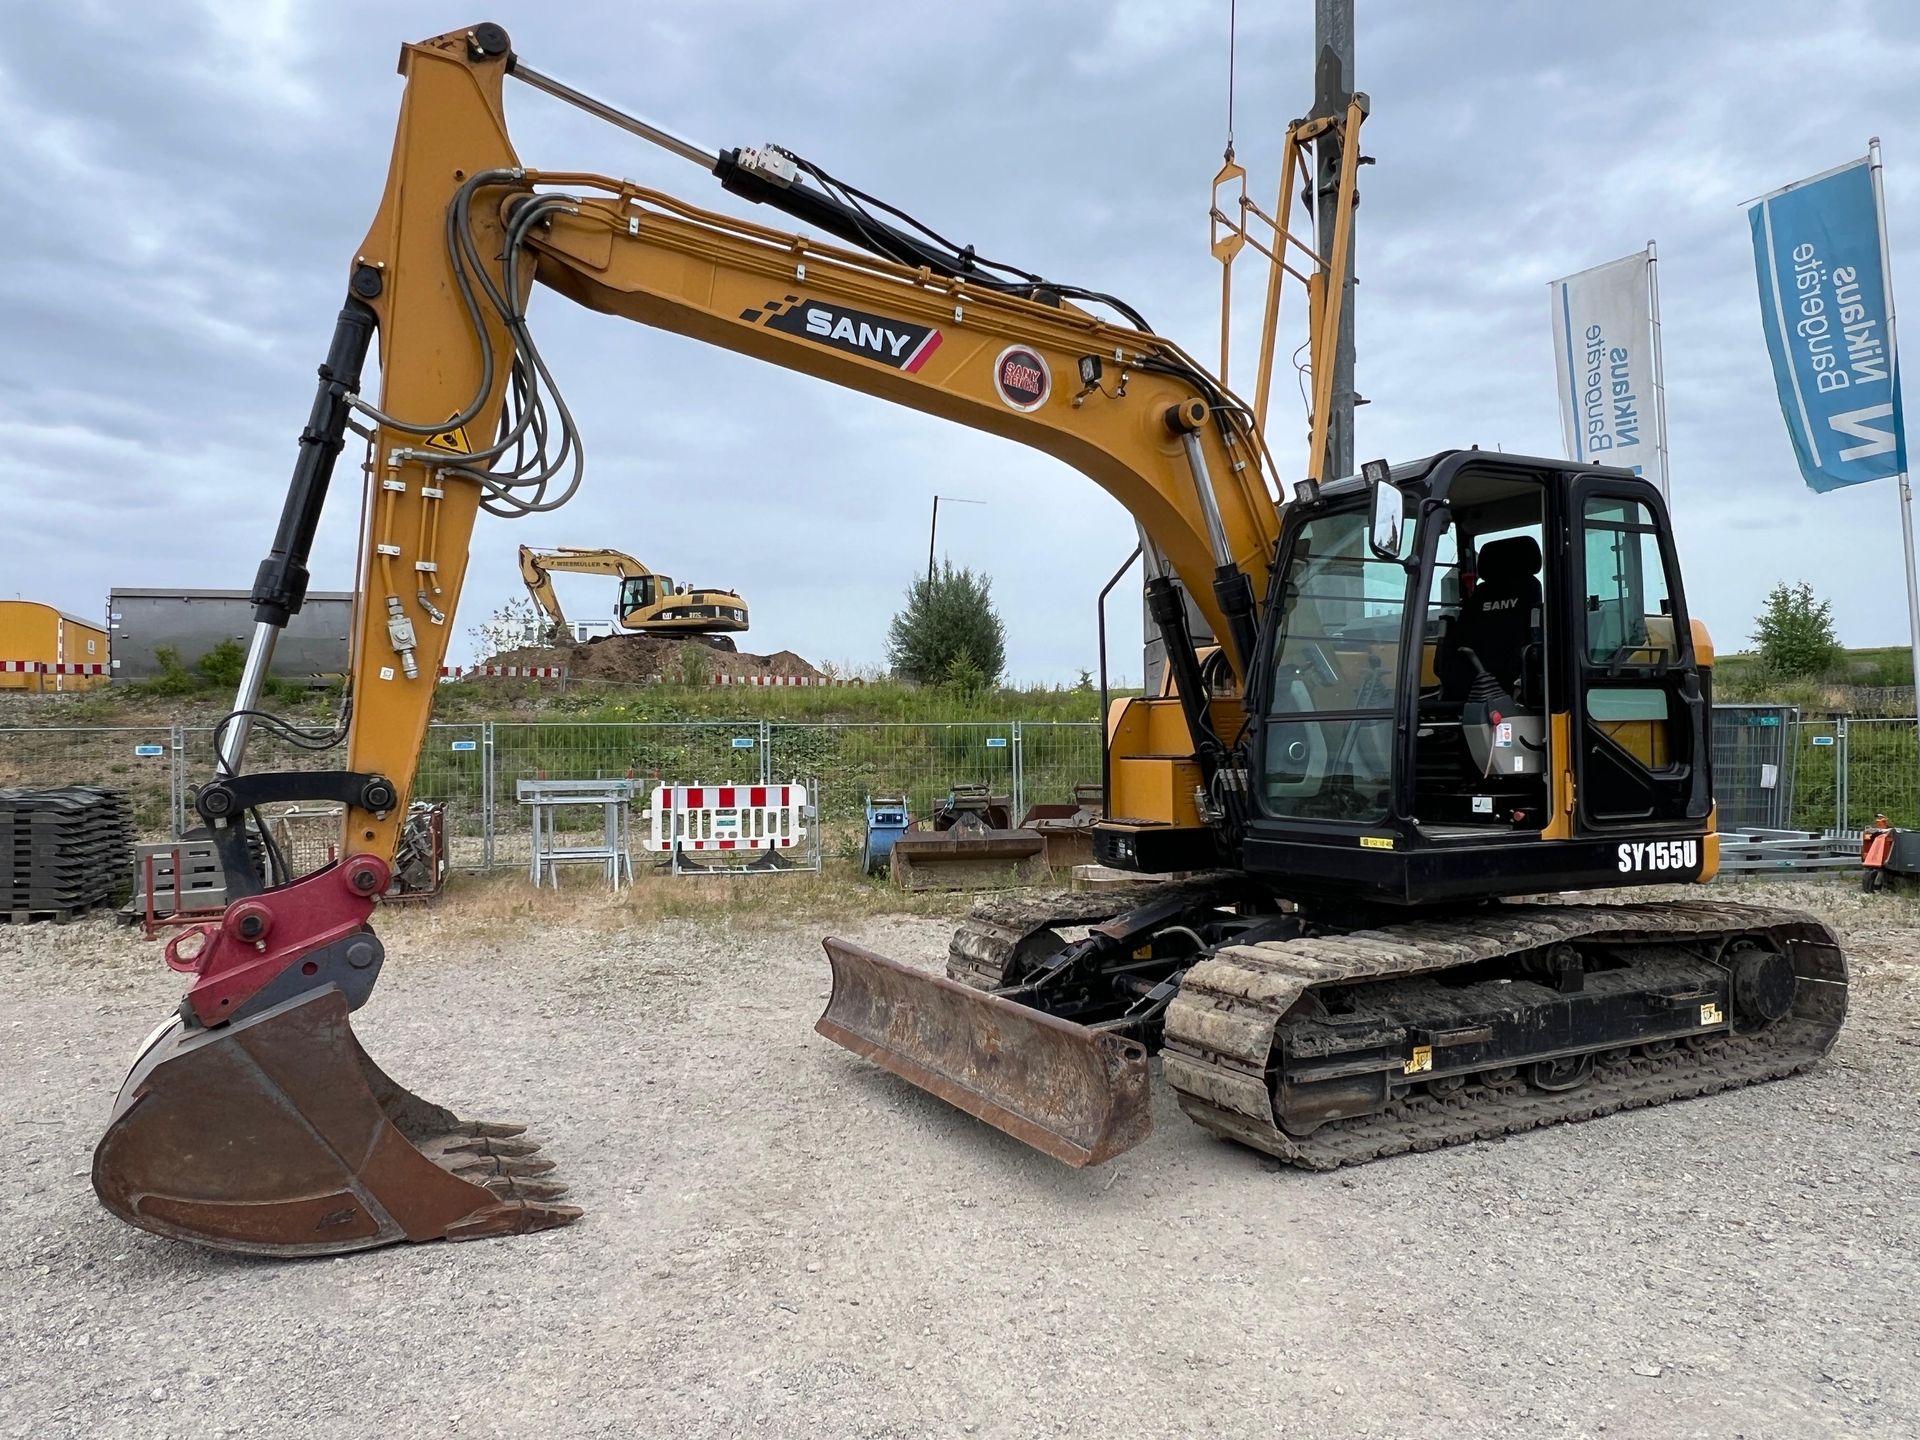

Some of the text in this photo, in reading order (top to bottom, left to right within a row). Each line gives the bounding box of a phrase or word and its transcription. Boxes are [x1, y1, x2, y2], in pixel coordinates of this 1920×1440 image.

[806, 308, 911, 356] SANY
[1005, 361, 1041, 382] SANY
[1482, 598, 1519, 611] SANY
[1617, 840, 1697, 873] SY155U
